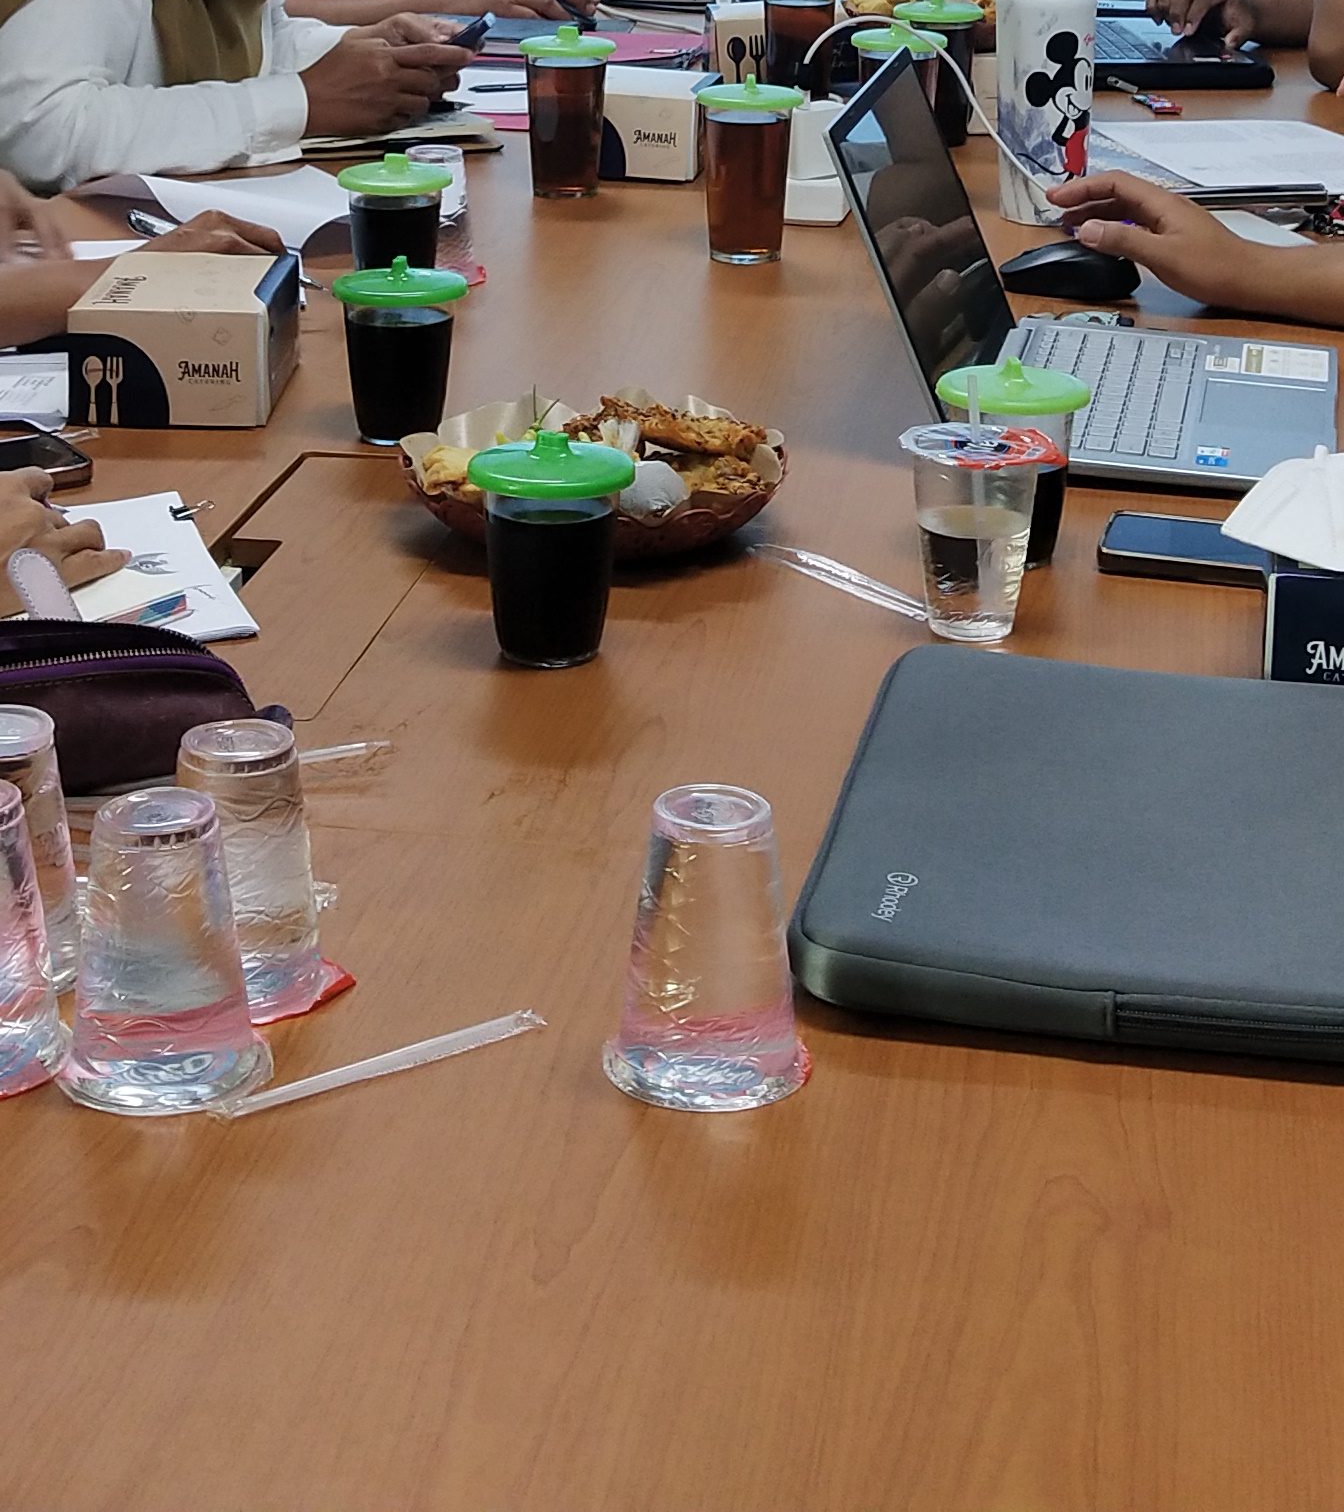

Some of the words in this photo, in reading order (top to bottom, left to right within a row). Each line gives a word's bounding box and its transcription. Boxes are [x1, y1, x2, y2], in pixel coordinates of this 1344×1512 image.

[633, 130, 677, 147] AMANAH
[178, 361, 241, 382] AMANAH
[871, 884, 908, 922] Rhodey
